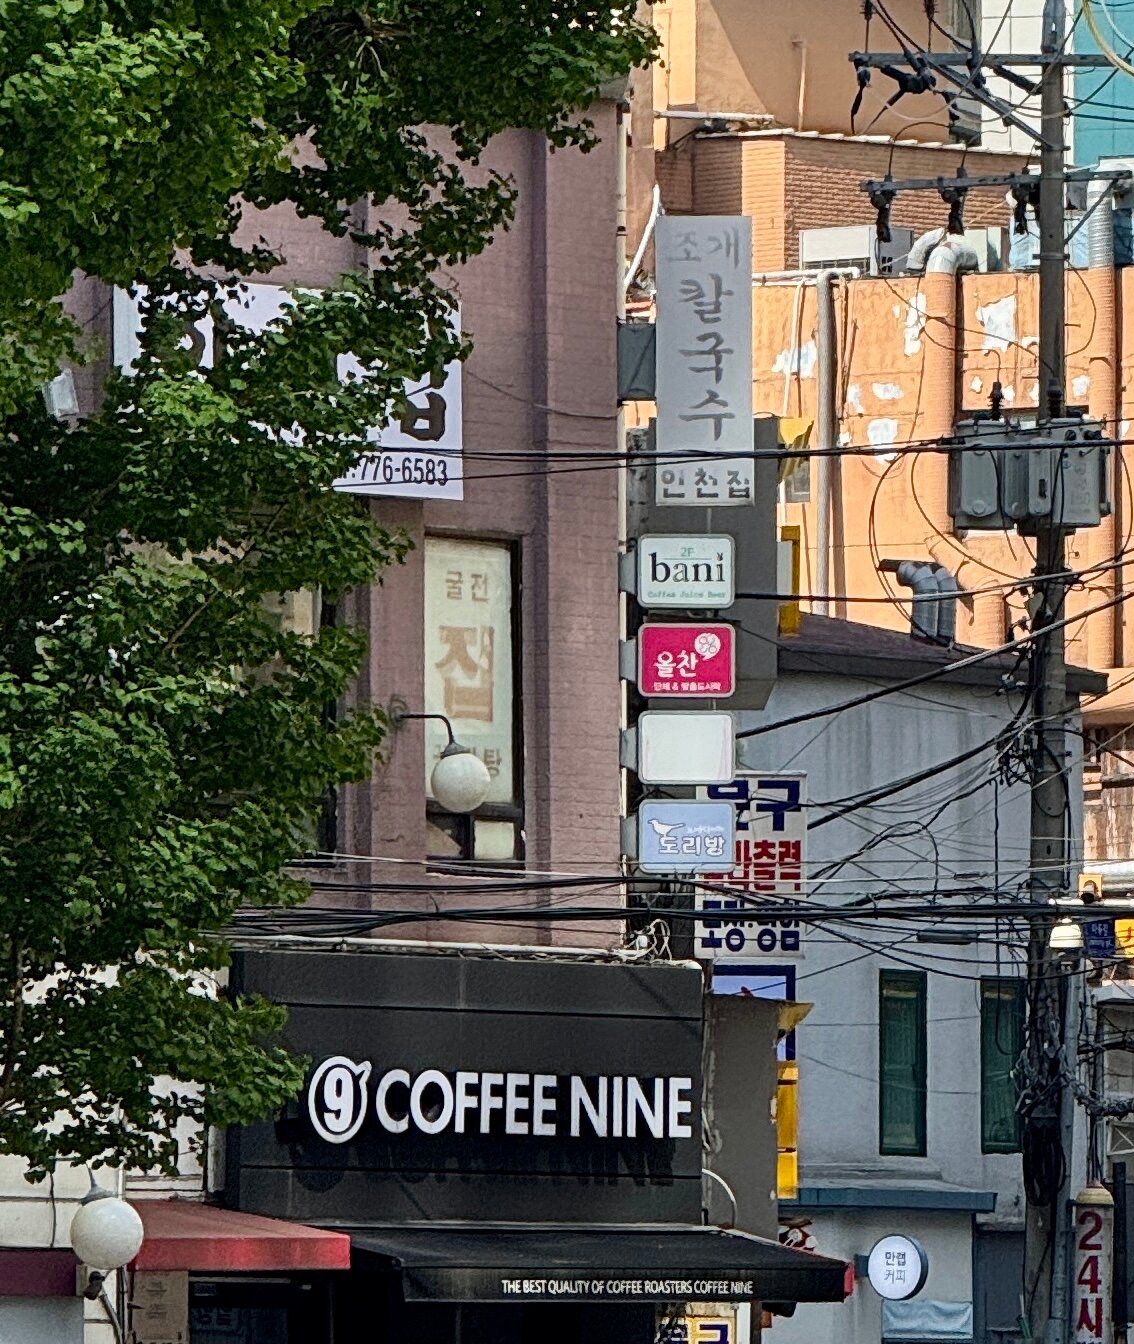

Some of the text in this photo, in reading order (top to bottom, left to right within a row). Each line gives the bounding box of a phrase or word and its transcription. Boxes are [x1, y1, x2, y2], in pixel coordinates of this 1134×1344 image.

[669, 227, 739, 268] 조개
[678, 273, 735, 442] 칼국수
[661, 467, 750, 499] 인천집
[648, 551, 726, 583] bani
[653, 649, 699, 678] 올찬
[659, 835, 726, 857] 도리방
[375, 1069, 557, 1135] COFFEE
[571, 1075, 692, 1138] NINE
[501, 1279, 753, 1294] THE BEST QUALITY OF COFFEE ROASTERS COFFEE NINE
[884, 1268, 906, 1284] 커피
[1076, 1210, 1103, 1339] 24시
